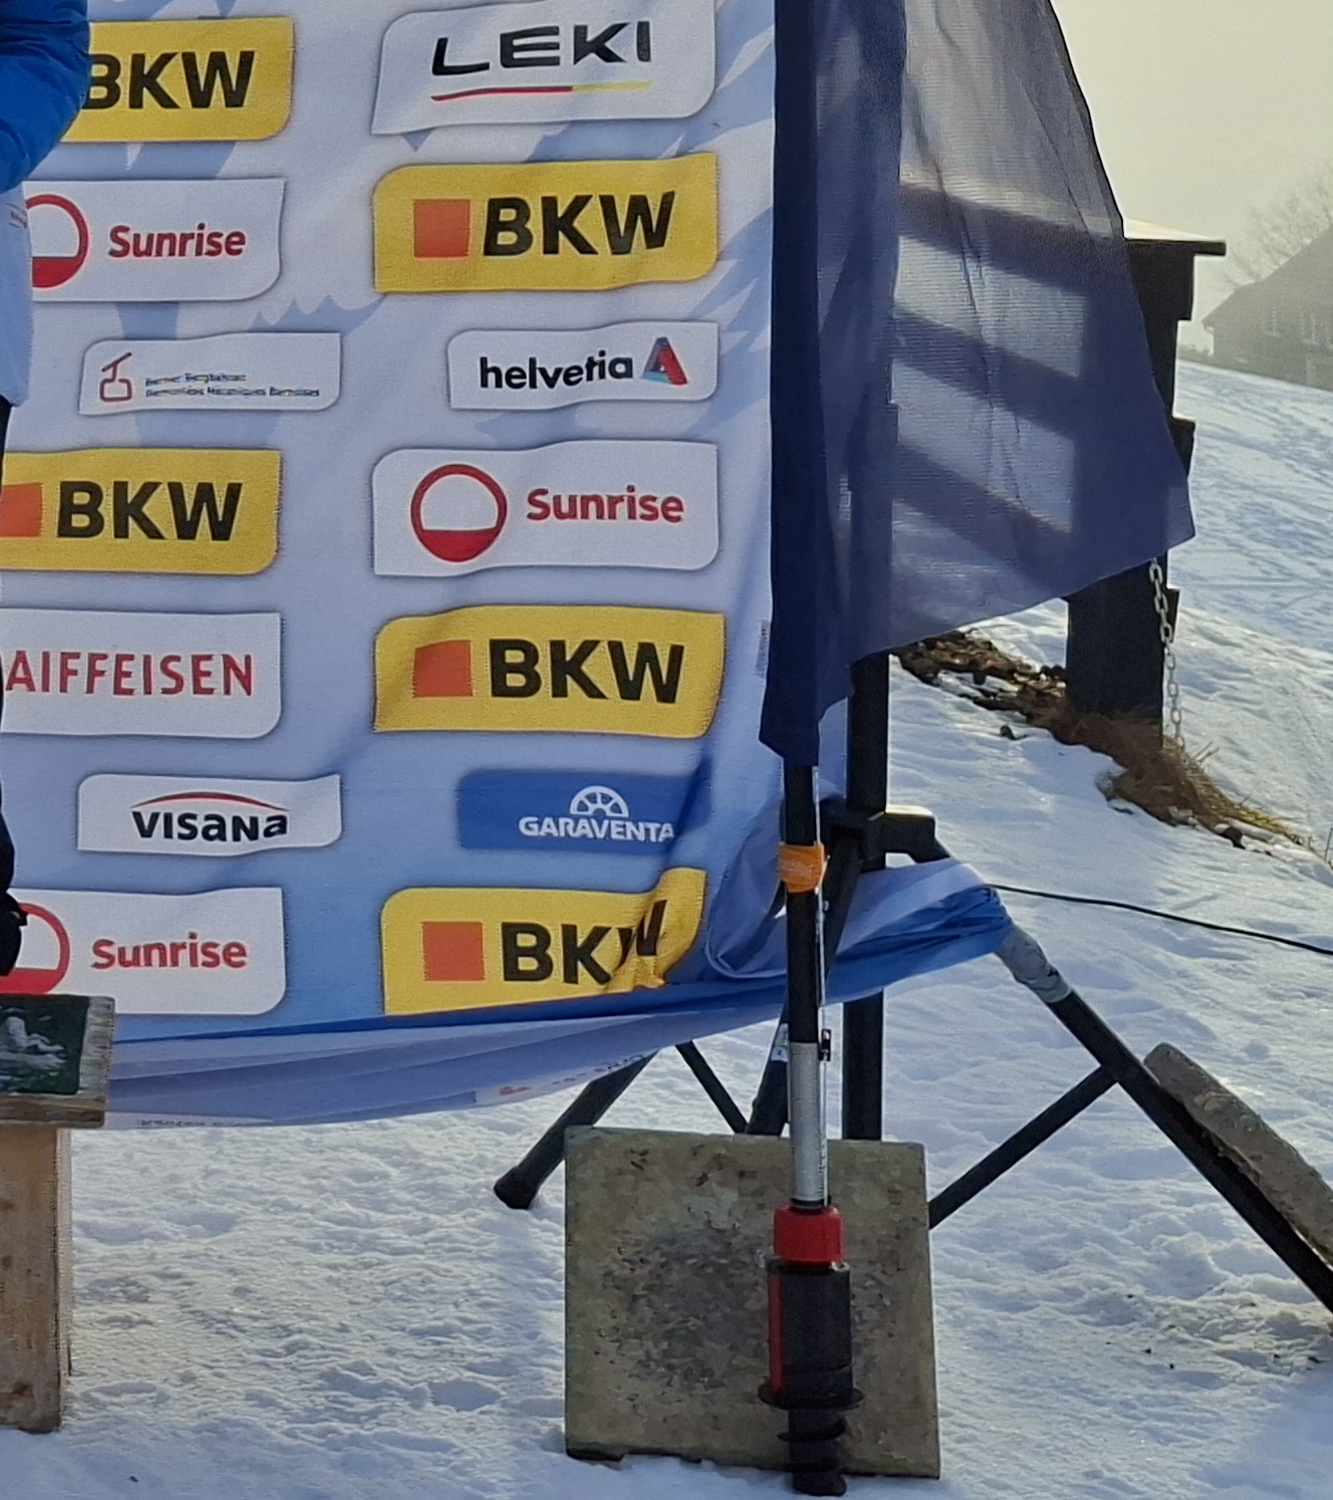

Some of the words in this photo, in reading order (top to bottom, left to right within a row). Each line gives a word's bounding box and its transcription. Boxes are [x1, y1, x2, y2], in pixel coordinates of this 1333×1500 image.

[432, 21, 651, 77] LEKI
[89, 51, 255, 110] BKW
[107, 224, 247, 258] Sunrise
[483, 191, 675, 256] BKW
[479, 350, 634, 392] helvetia
[56, 481, 243, 541] BKW
[527, 485, 685, 524] Sunrise
[5, 651, 254, 698] AIFFEISEN
[488, 638, 685, 704] BKW
[519, 817, 675, 842] GARAVENTA
[91, 933, 247, 969] Sunrise
[503, 900, 667, 985] BKW
